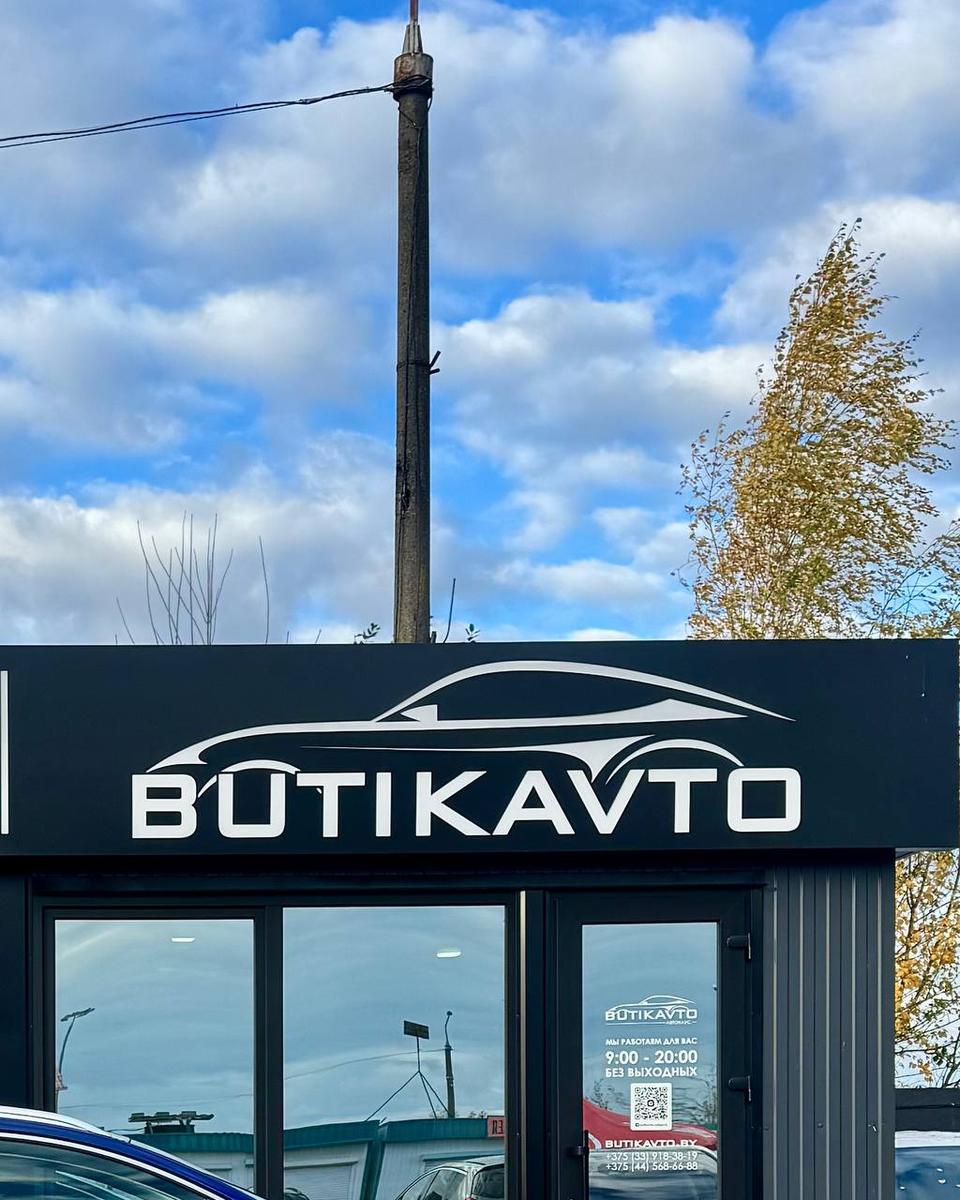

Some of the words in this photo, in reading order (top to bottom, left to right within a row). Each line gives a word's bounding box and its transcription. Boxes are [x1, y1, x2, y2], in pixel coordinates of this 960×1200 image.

[131, 767, 802, 839] BUTIKAVTO
[605, 1009, 698, 1021] BUTIKAVTO
[621, 1038, 662, 1046] РАБОТАЕМ
[663, 1038, 680, 1046] ДЛЯ
[681, 1037, 697, 1045] ВАС
[605, 1051, 638, 1065] 9:00
[654, 1049, 698, 1064] 20:00
[605, 1068, 624, 1078] БЕЗ
[627, 1067, 698, 1078] ВЫХОДНЫХ
[605, 1139, 698, 1148] BUTIKAVTO.BY
[606, 1152, 629, 1161] +375
[631, 1151, 649, 1162] (33)
[652, 1151, 698, 1161] 918-38-19
[606, 1162, 629, 1171] +375
[631, 1161, 649, 1172] (44)
[652, 1161, 698, 1171] 568-66-88
